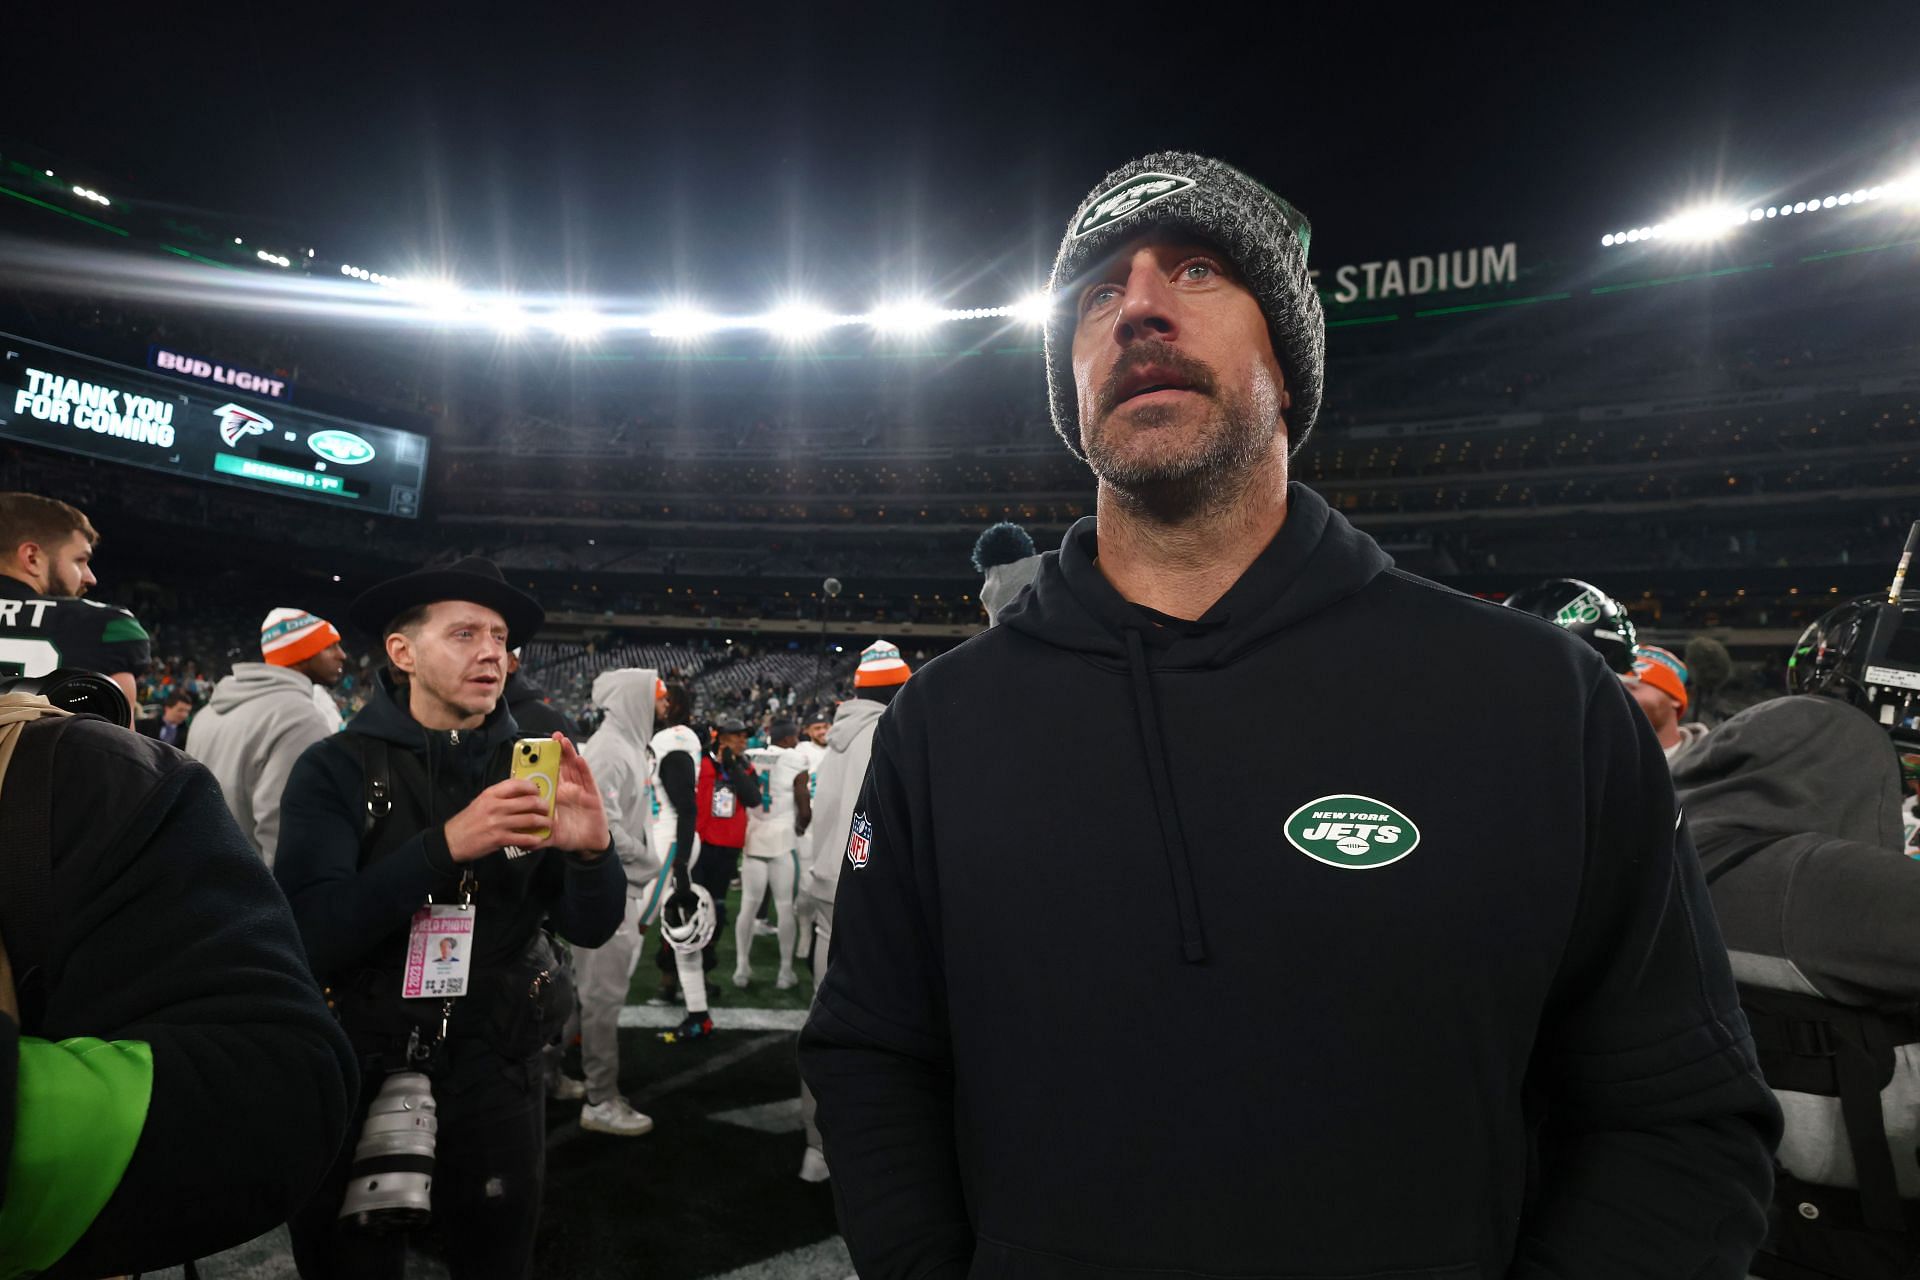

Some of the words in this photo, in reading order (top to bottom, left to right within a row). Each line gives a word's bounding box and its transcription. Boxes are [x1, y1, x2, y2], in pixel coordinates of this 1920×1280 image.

[1335, 243, 1516, 302] STADIUM
[26, 368, 120, 413] THANK
[123, 393, 173, 425] YOU
[157, 351, 212, 377] BUD
[213, 366, 284, 397] LIGHT
[14, 389, 70, 425] FOR
[73, 405, 175, 447] COMING
[1302, 822, 1402, 844] JETS
[1312, 811, 1347, 819] NEW
[1349, 812, 1390, 821] YORK
[850, 832, 868, 861] NFL
